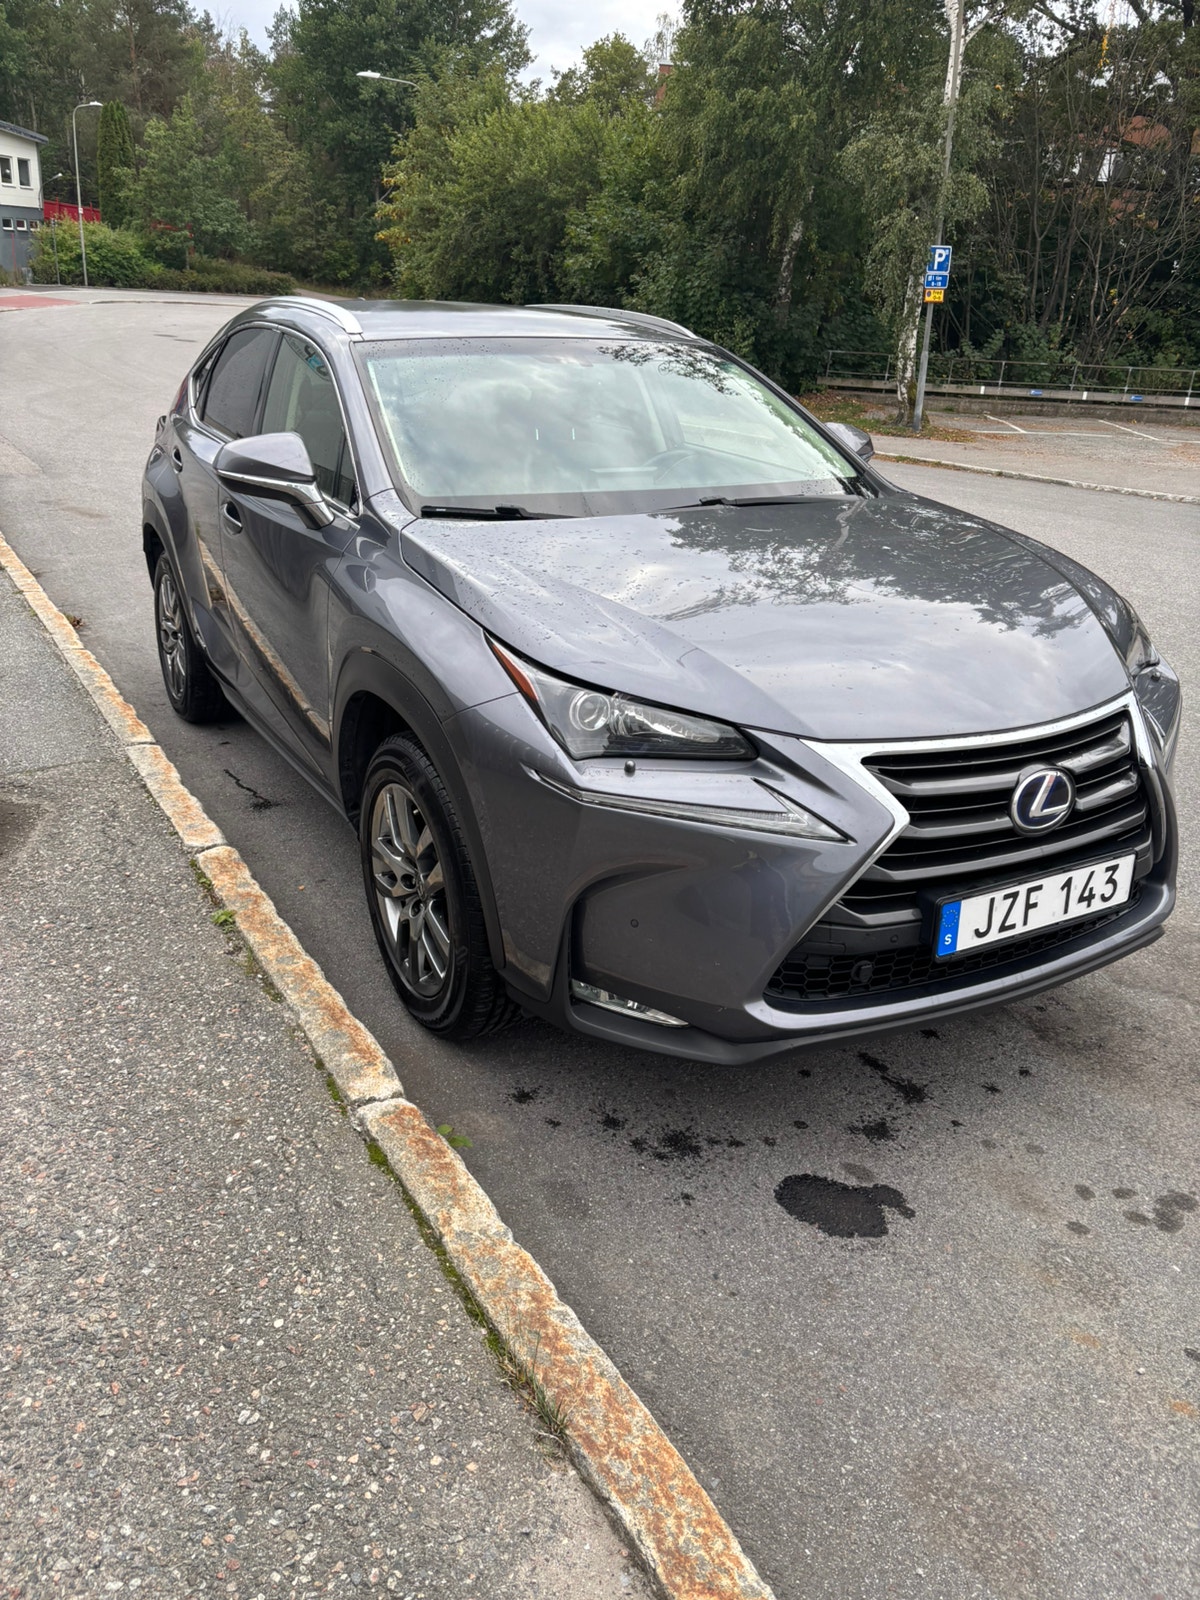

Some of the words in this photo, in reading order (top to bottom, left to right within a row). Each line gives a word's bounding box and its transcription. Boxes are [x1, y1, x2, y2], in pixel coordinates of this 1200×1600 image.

[933, 249, 946, 270] P
[974, 884, 1044, 939] JZF
[1060, 863, 1120, 915] 143
[944, 933, 952, 945] S
